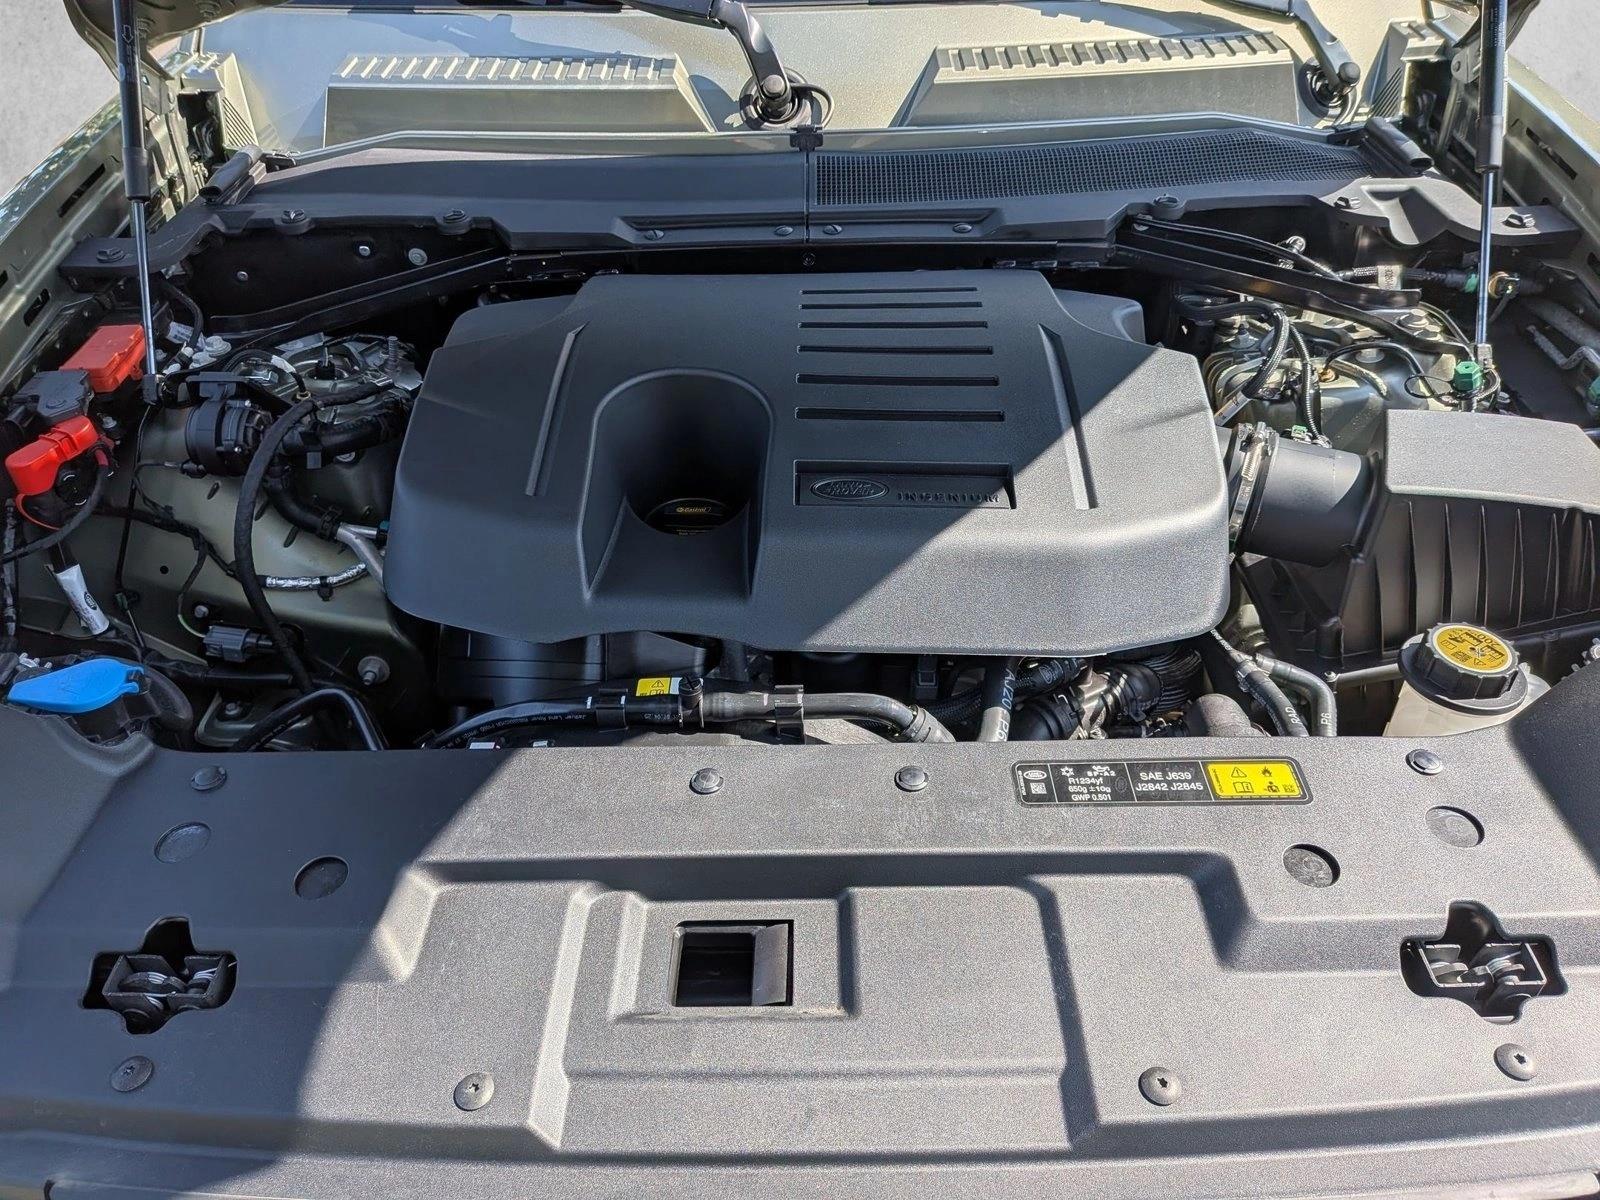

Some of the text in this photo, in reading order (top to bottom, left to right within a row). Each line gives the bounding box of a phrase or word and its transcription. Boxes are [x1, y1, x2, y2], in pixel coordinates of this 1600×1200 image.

[1140, 771, 1192, 781] SAE J639
[1068, 777, 1104, 786] R1234yf
[1135, 782, 1204, 791] J2842 J2845
[1071, 793, 1112, 801] GWP 0.501
